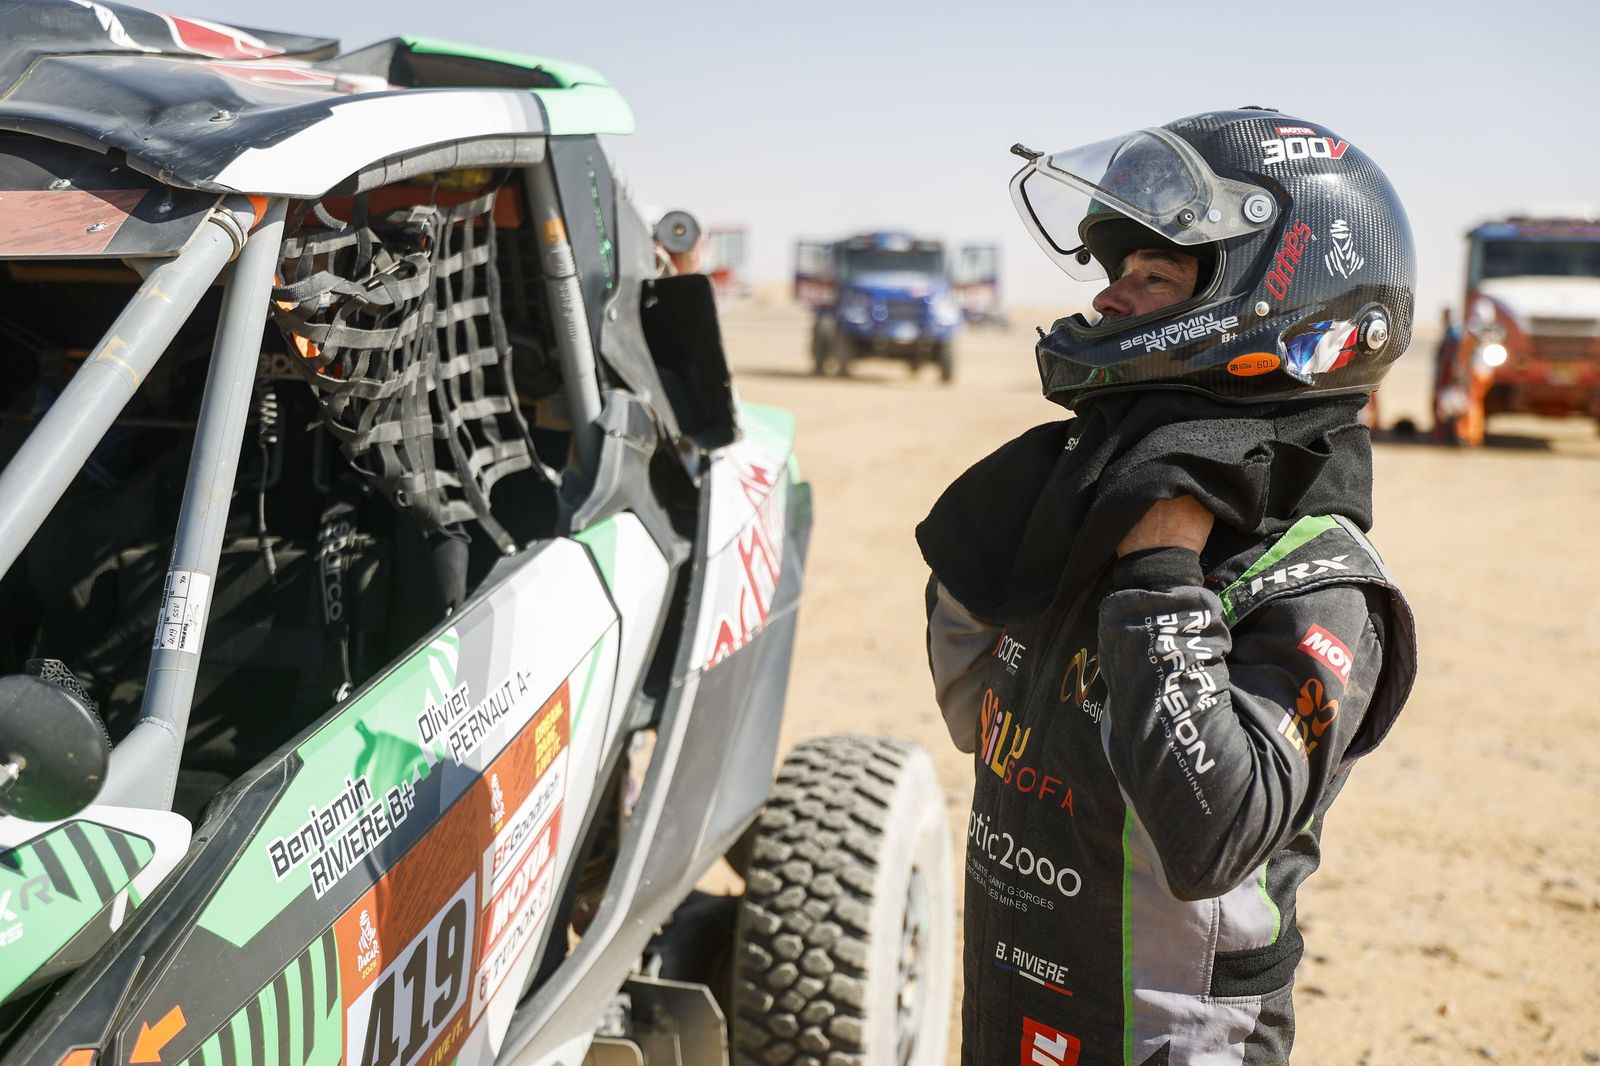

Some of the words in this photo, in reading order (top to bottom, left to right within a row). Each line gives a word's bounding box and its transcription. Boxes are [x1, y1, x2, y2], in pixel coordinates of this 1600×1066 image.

[1261, 137, 1349, 165] 300V
[1278, 127, 1315, 136] MOTUL
[1221, 332, 1238, 344] B+
[1256, 359, 1275, 369] 601
[1250, 554, 1350, 597] HRX
[418, 686, 468, 745] Olivier
[449, 681, 515, 762] PERNAUT
[1004, 760, 1074, 817] SOFA
[1168, 741, 1212, 815] MACHINERY
[269, 778, 371, 878] Benjamin
[310, 803, 391, 895] RIVIERE
[387, 783, 413, 823] B+
[492, 772, 560, 874] BFGoodrich
[490, 826, 552, 945] MOTUL
[360, 898, 467, 1066] 419
[995, 941, 1008, 961] B.
[1012, 946, 1069, 985] RIVIERE
